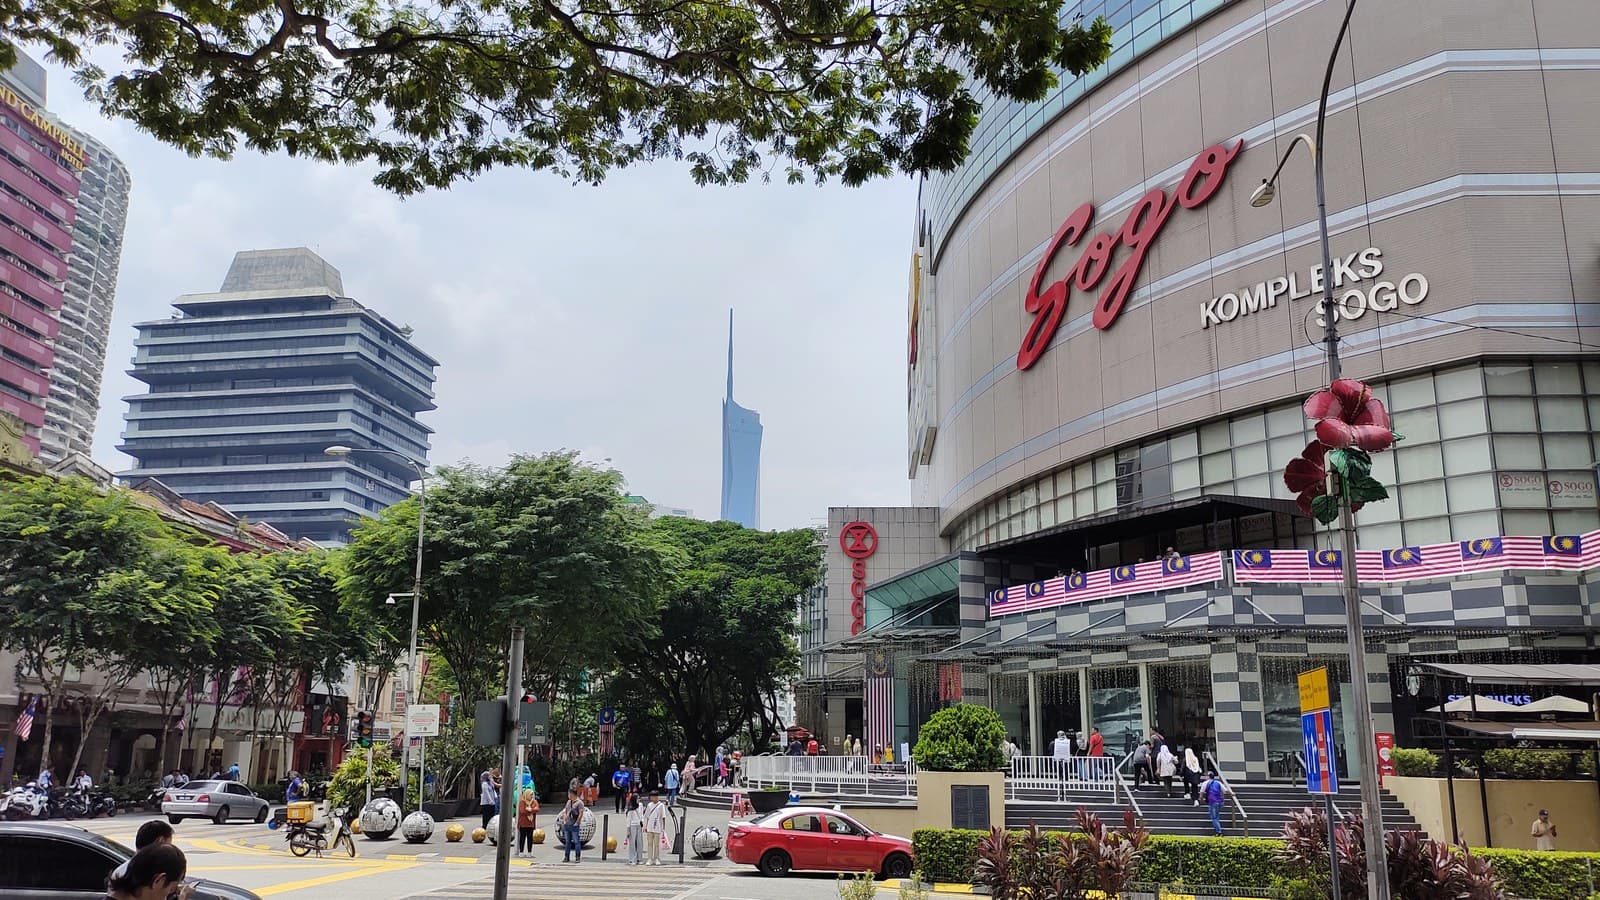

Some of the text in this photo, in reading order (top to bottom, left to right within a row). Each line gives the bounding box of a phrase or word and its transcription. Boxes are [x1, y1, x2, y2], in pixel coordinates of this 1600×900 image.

[20, 103, 84, 160] CAMPBELL
[61, 148, 84, 171] HOTEL
[1016, 138, 1244, 370] Sogo
[1200, 247, 1383, 329] KOMPLEKS
[1315, 272, 1429, 327] SOGO
[1563, 480, 1593, 491] SOGO
[1447, 695, 1531, 705] STUCKS
